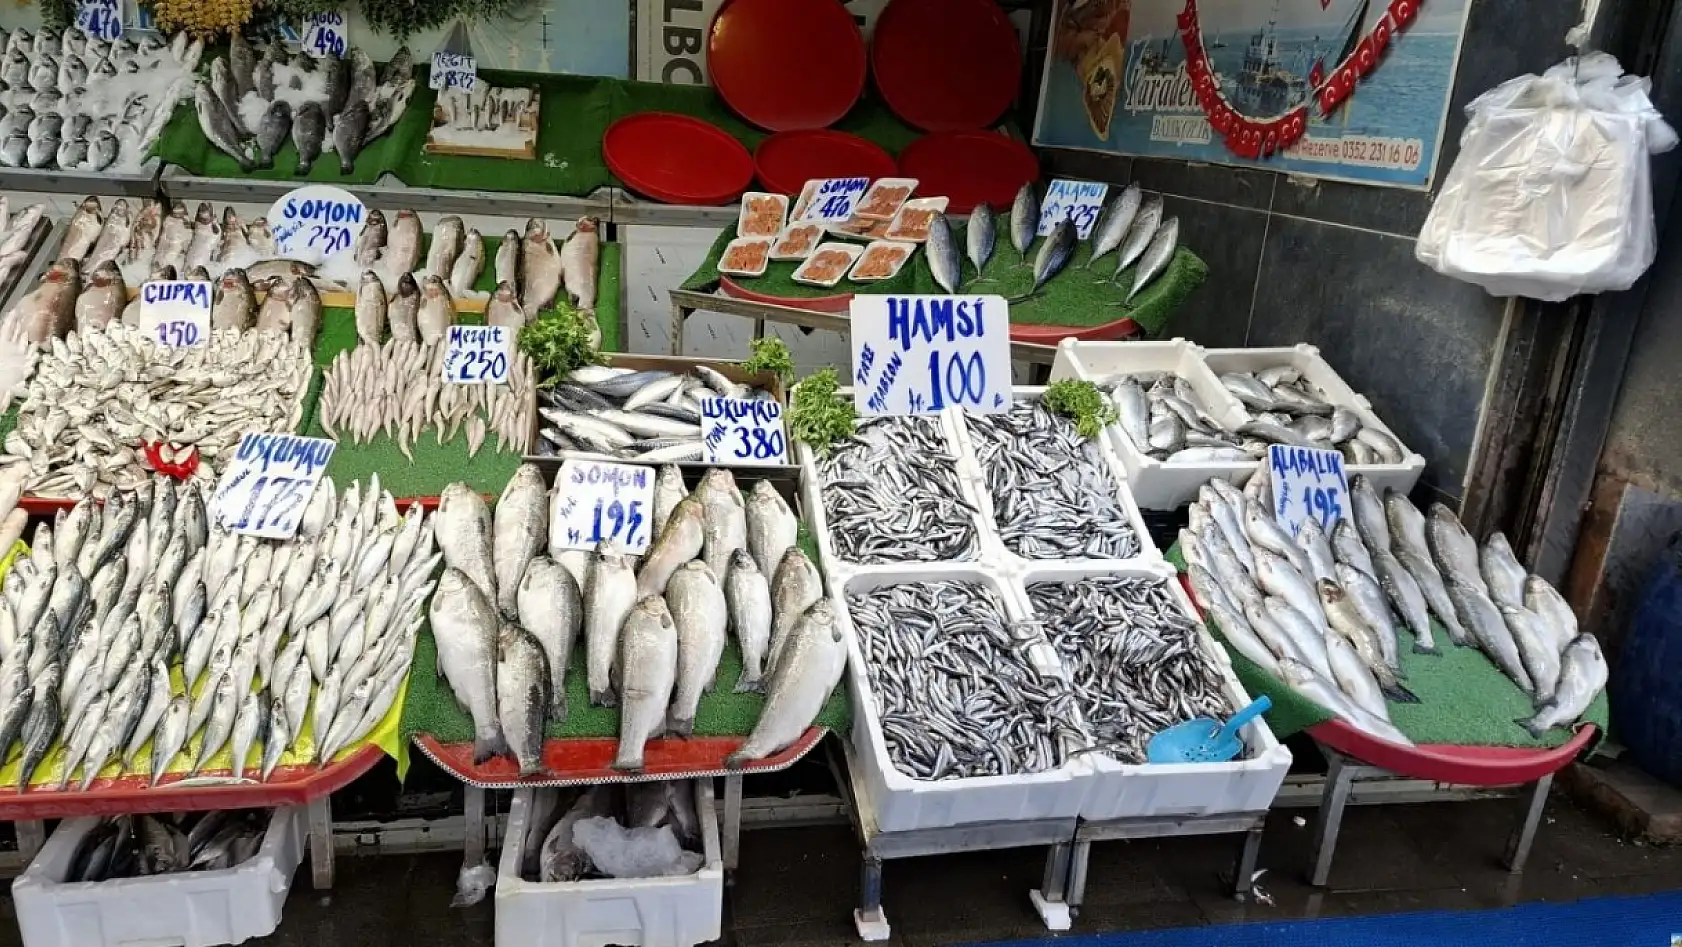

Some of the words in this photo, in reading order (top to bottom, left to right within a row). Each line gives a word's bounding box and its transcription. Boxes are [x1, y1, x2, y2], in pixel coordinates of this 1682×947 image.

[88, 8, 120, 38] 470
[315, 27, 344, 59] 490
[1343, 140, 1367, 161] 0352
[820, 179, 866, 195] SOMON
[283, 199, 361, 225] SOMON
[1064, 203, 1101, 230] 325
[155, 321, 198, 347] 150
[460, 350, 506, 380] 250
[926, 350, 986, 410] 100
[702, 397, 779, 427] USKUMRU
[733, 426, 784, 458] 380
[571, 465, 646, 497] SOMON
[1271, 445, 1348, 494] ALABALIK
[586, 497, 643, 545] 195
[1304, 486, 1341, 528] 195
